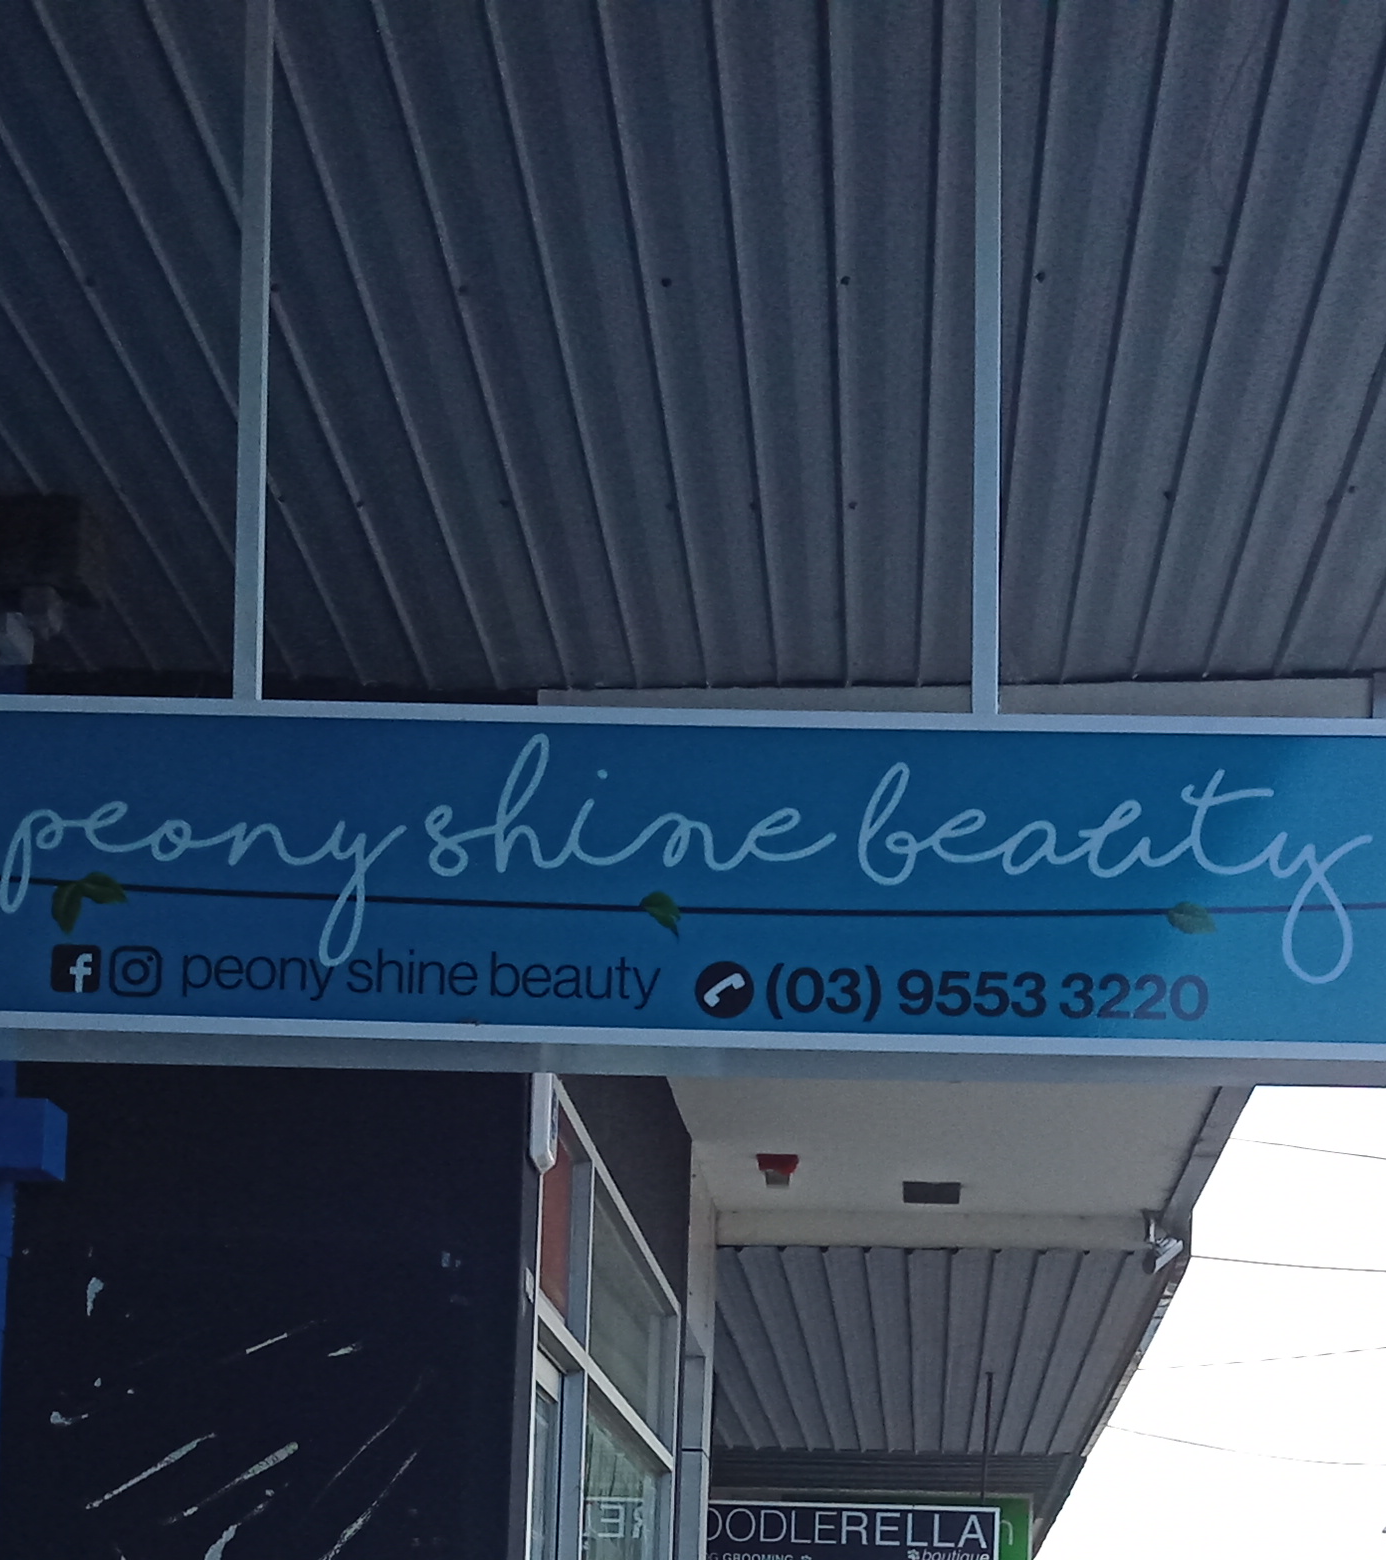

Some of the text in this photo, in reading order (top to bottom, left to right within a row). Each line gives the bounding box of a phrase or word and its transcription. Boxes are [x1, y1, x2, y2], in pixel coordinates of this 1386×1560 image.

[425, 733, 836, 878] shine
[858, 761, 1373, 985] beauty
[182, 948, 660, 1009] peony shine beauty
[766, 963, 1209, 1022] (03) 9553 3220
